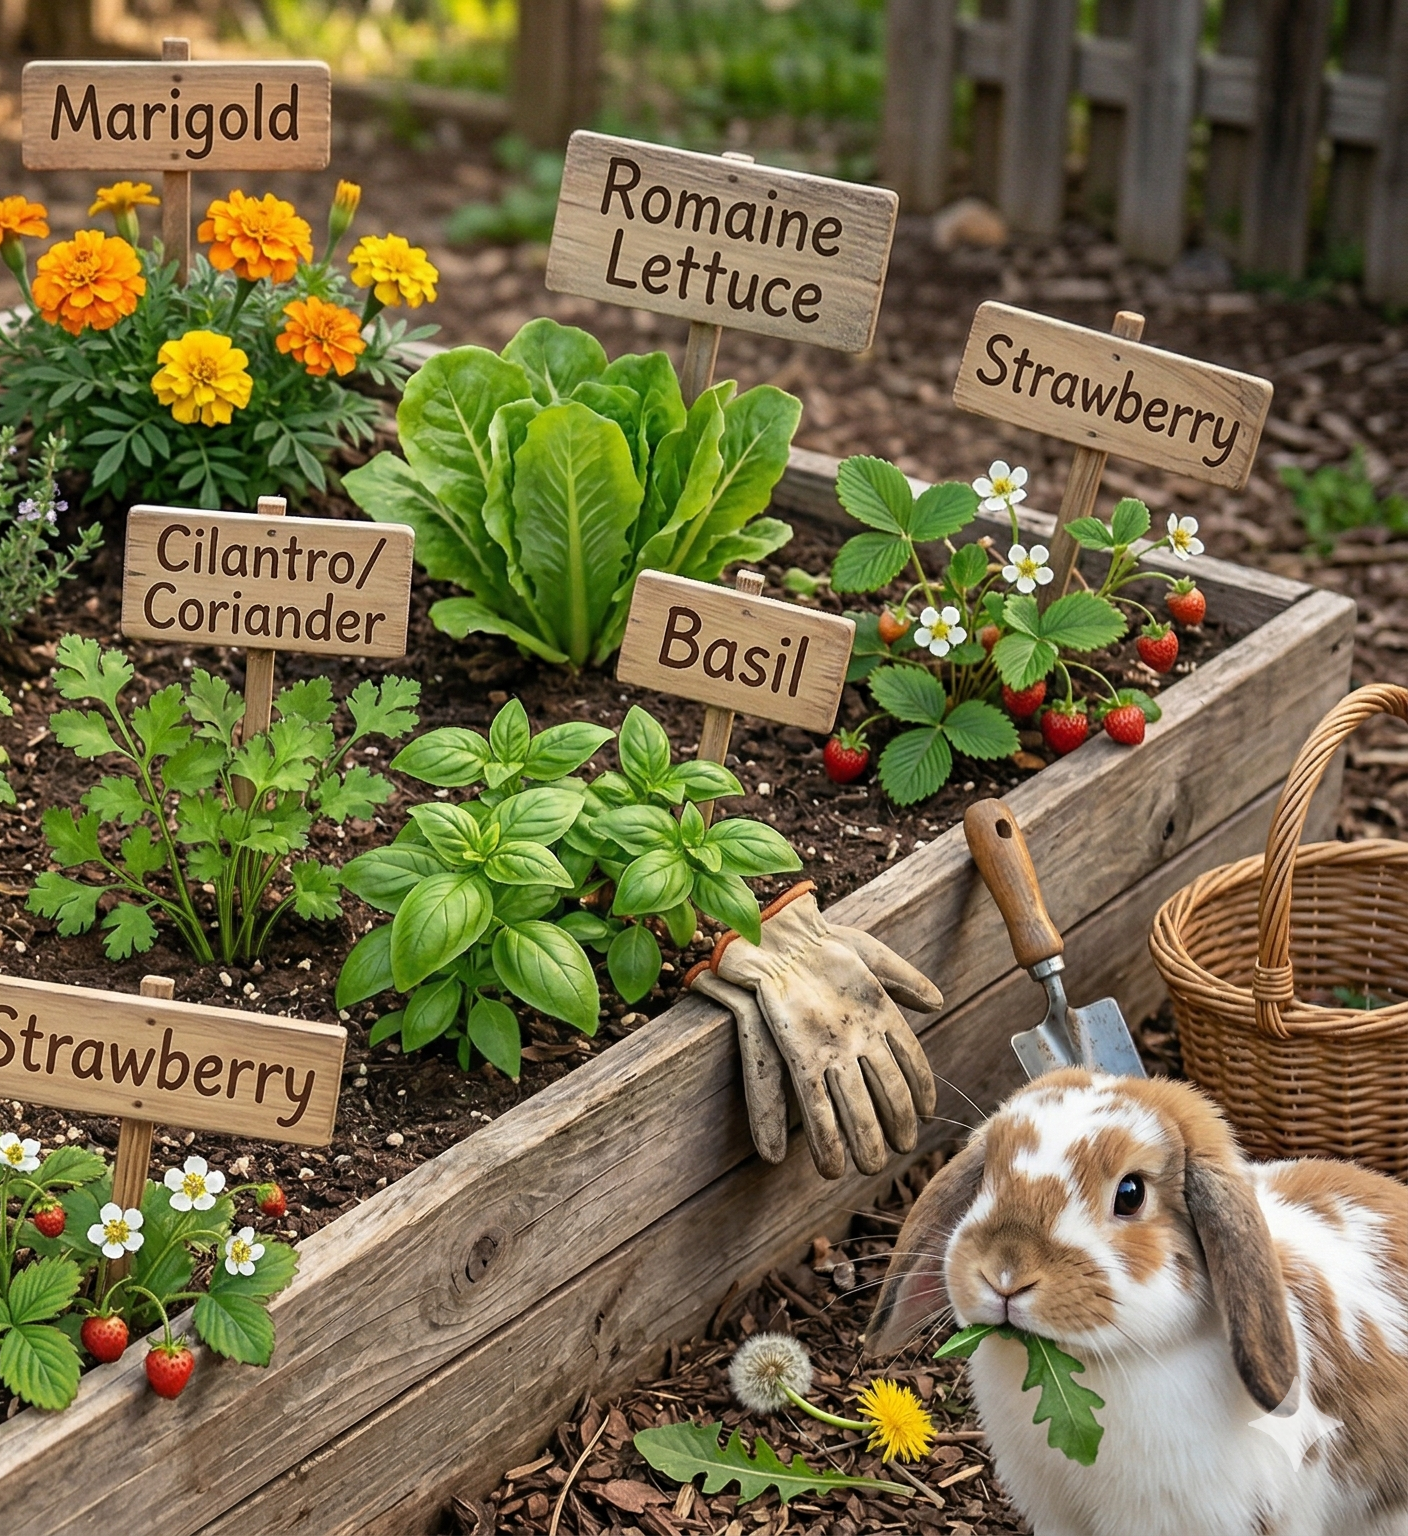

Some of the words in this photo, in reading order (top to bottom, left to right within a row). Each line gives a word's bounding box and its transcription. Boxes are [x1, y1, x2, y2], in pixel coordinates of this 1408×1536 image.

[50, 82, 299, 160] Marigold
[600, 155, 843, 258] Romaine
[605, 228, 823, 324] Lettuce
[975, 333, 1241, 468] Strawberry
[156, 523, 388, 590] Cilantro/
[143, 581, 386, 646] Coriander
[658, 605, 810, 698] Basil
